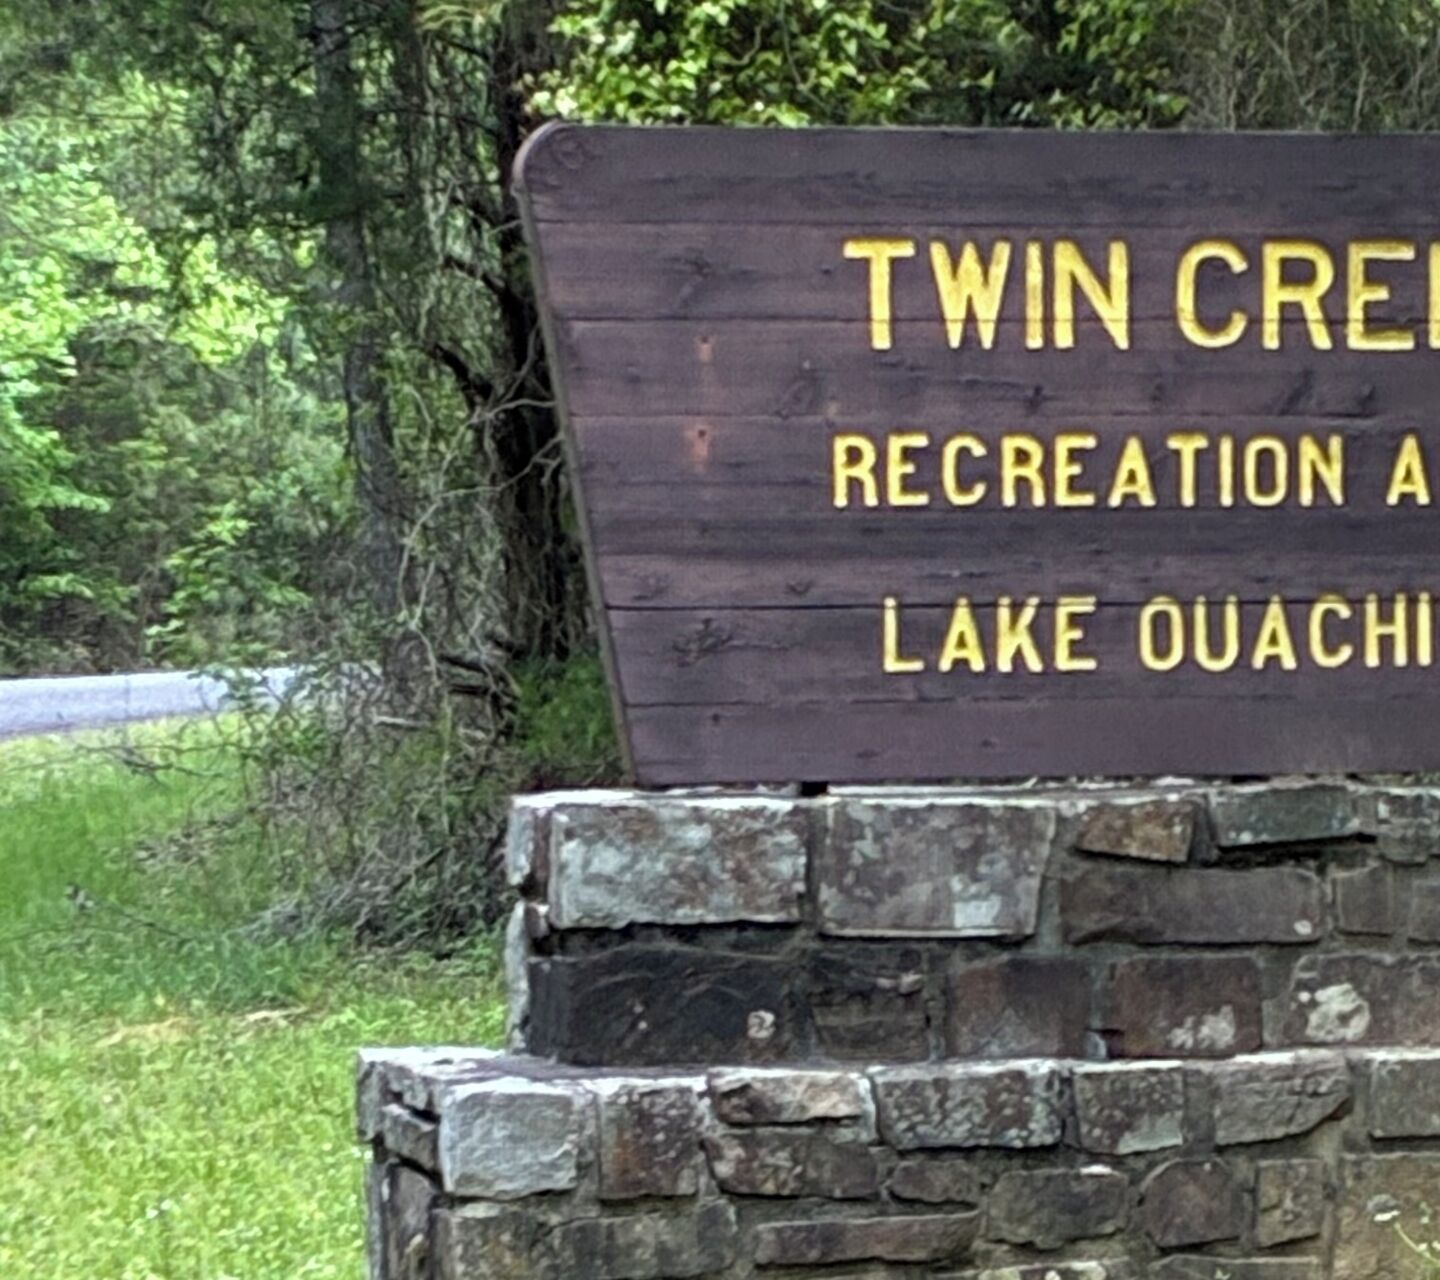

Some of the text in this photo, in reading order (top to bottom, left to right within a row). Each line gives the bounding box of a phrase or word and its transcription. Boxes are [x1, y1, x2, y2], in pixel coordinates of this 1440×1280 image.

[842, 240, 1131, 350] TWIN
[832, 433, 1344, 508] RECREATION
[882, 595, 1098, 673] LAKE
